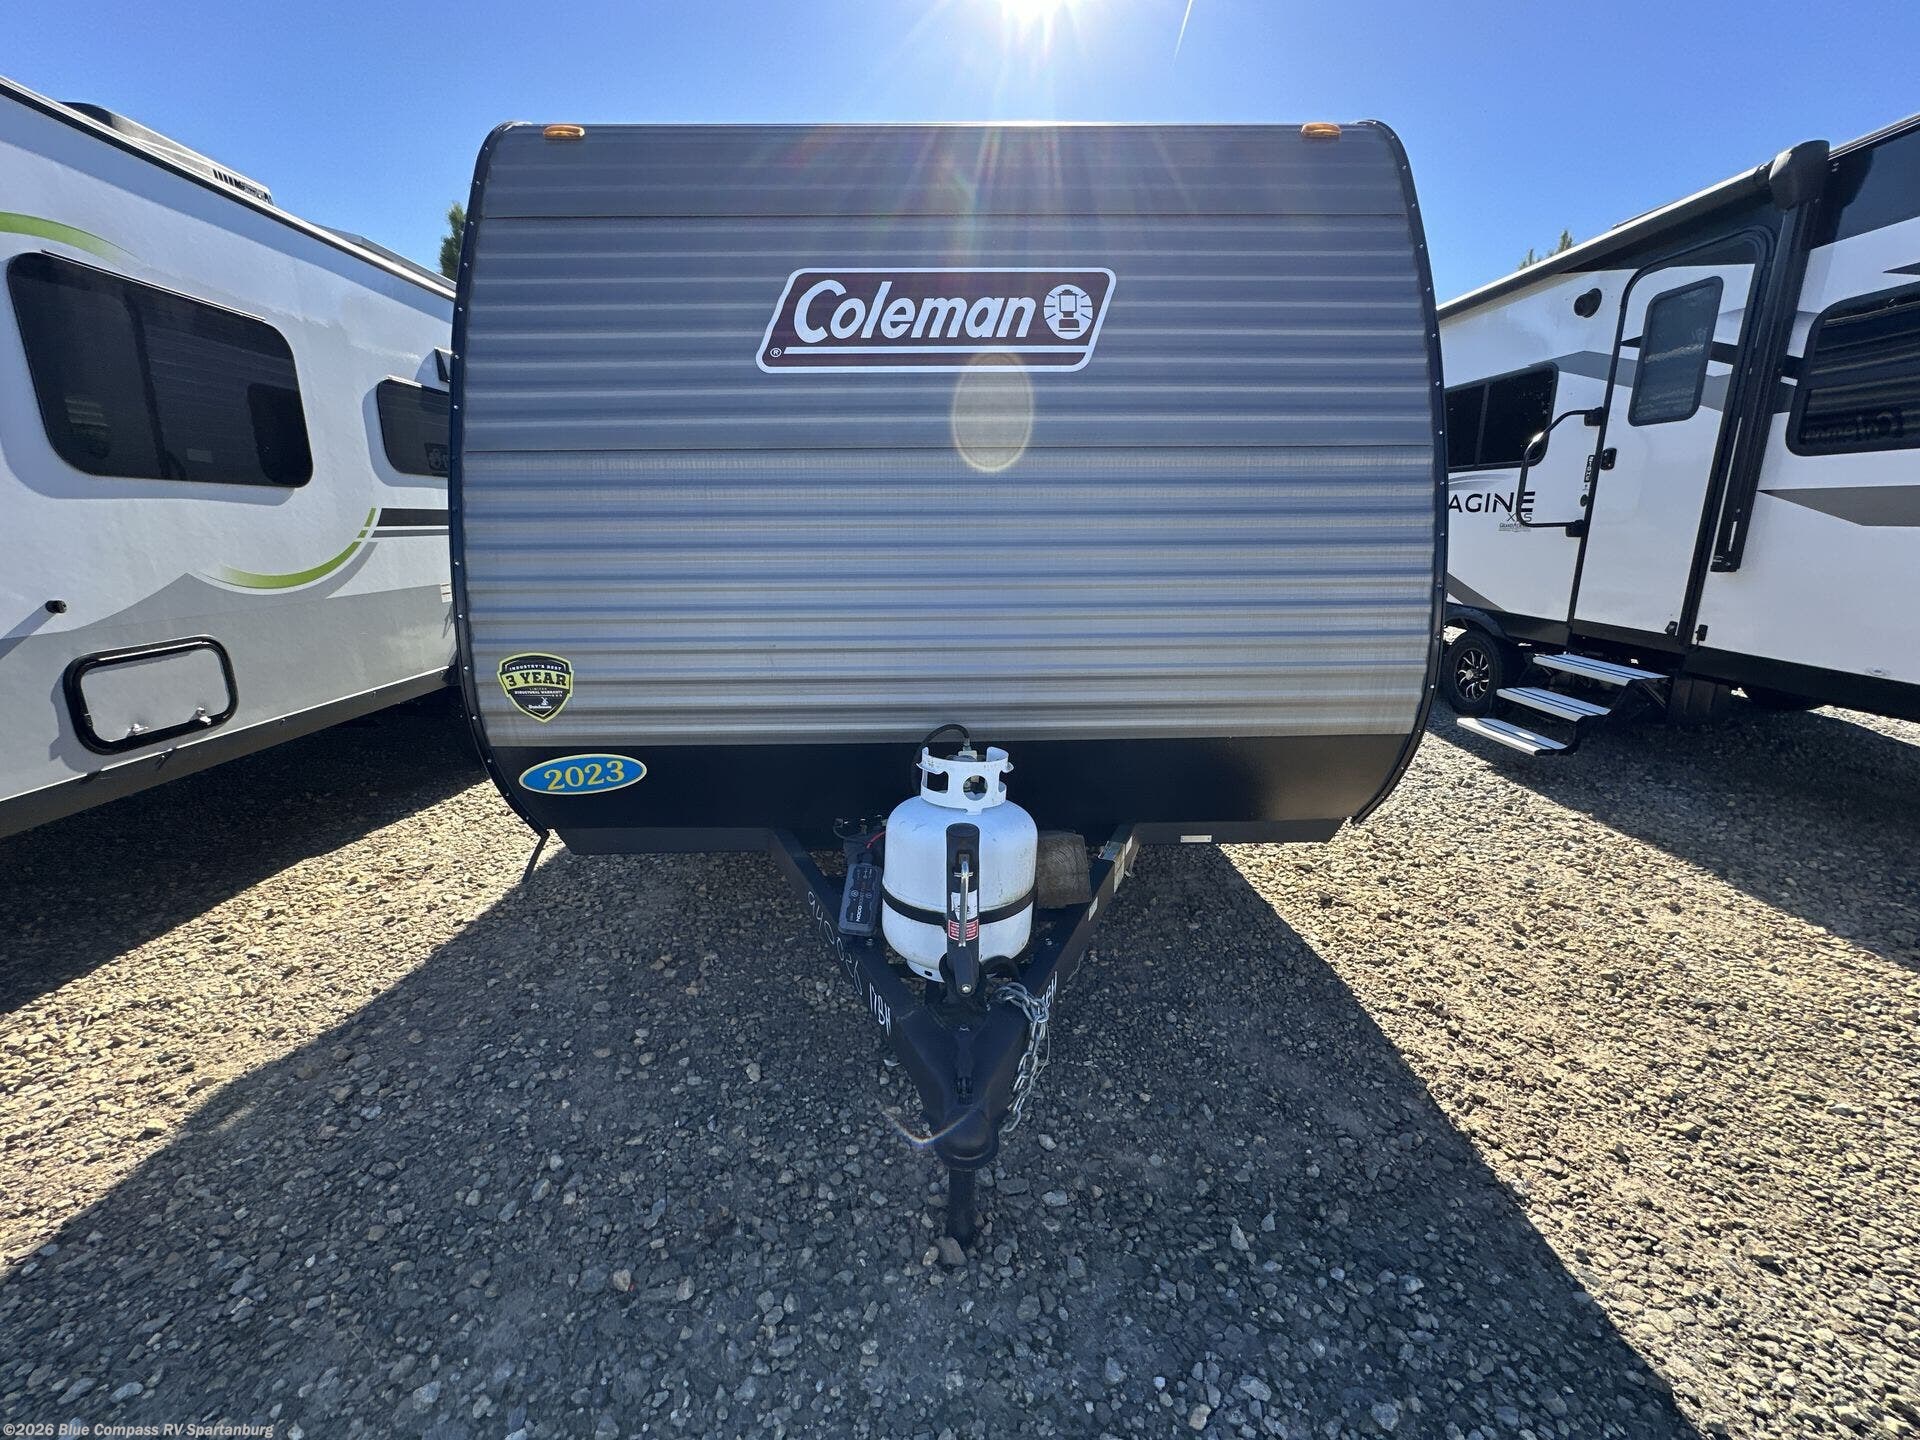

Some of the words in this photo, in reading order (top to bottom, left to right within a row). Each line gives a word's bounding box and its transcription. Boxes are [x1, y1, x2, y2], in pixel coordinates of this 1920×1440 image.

[794, 279, 1037, 343] Coleman
[1507, 512, 1533, 522] XS
[505, 674, 518, 687] 3
[519, 671, 567, 687] YEAR
[544, 760, 625, 791] 2023
[869, 982, 892, 1037] 17BH
